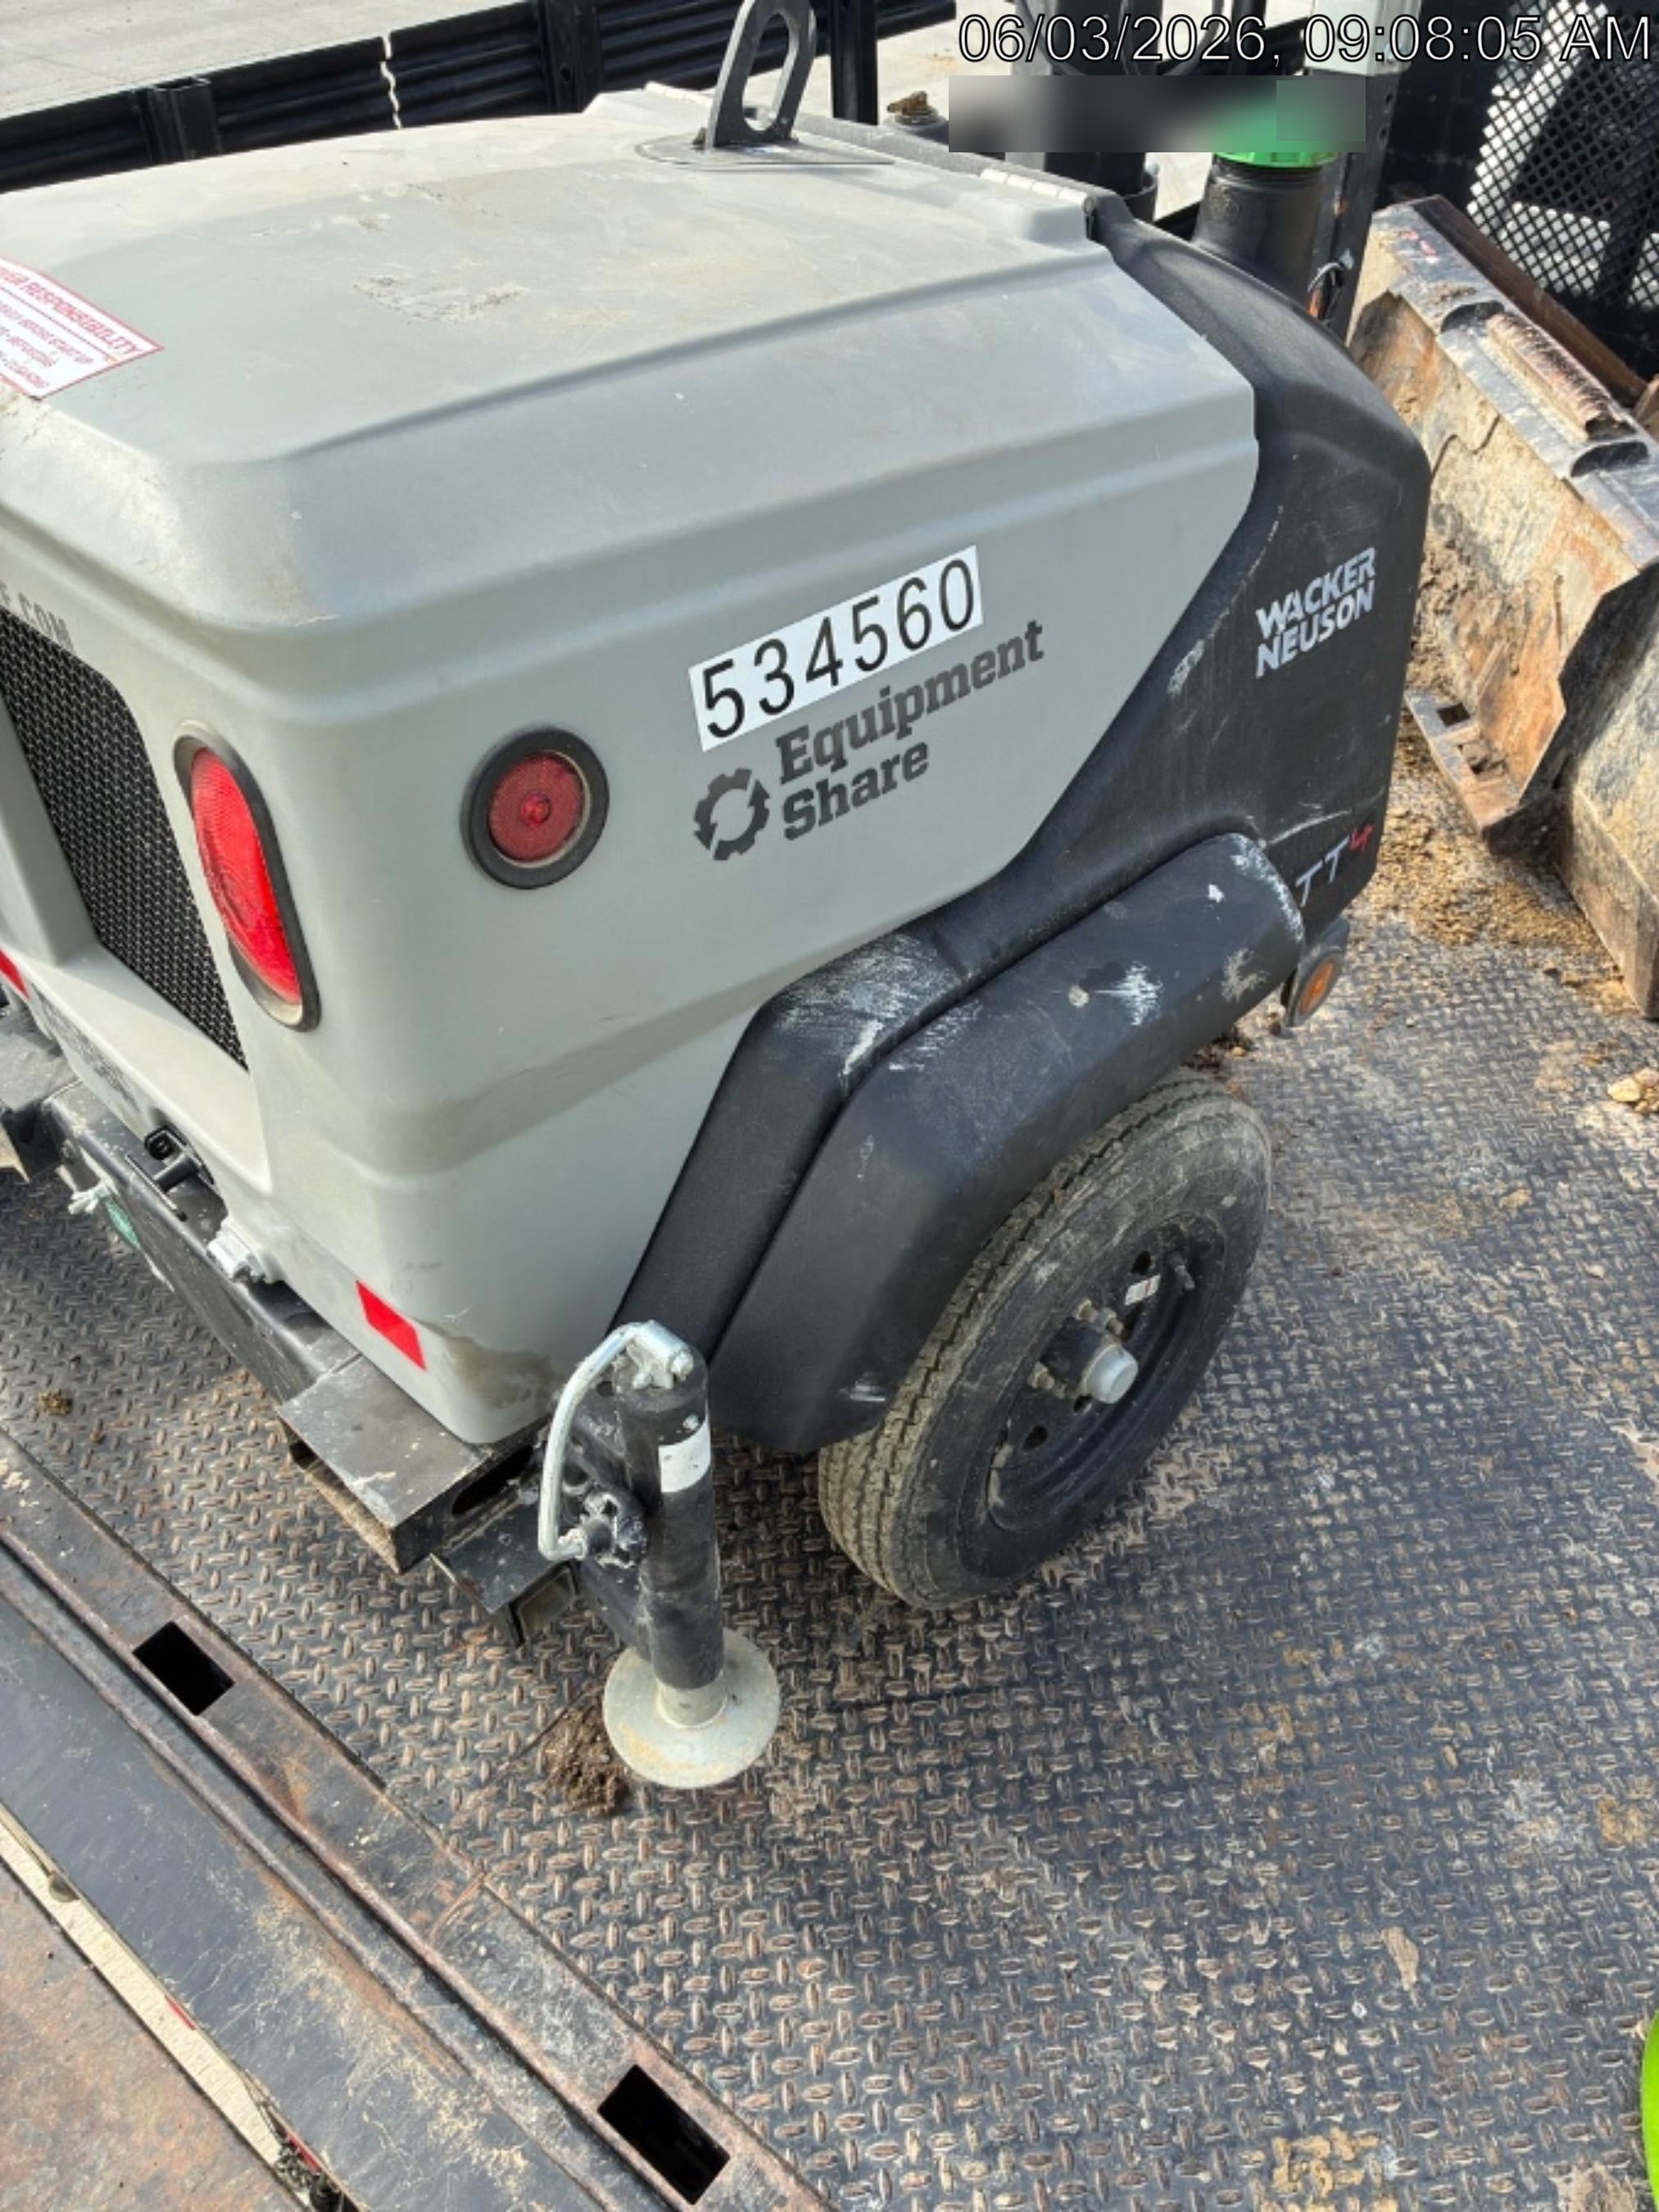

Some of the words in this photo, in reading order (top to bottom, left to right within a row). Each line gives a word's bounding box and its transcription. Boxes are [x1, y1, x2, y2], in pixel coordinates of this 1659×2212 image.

[1256, 547, 1376, 640] WACKER
[1256, 578, 1376, 680] NEUSON
[702, 558, 975, 739] 534560
[775, 619, 1045, 785] Equipment
[782, 741, 930, 841] Share
[1295, 824, 1374, 909] TT4
